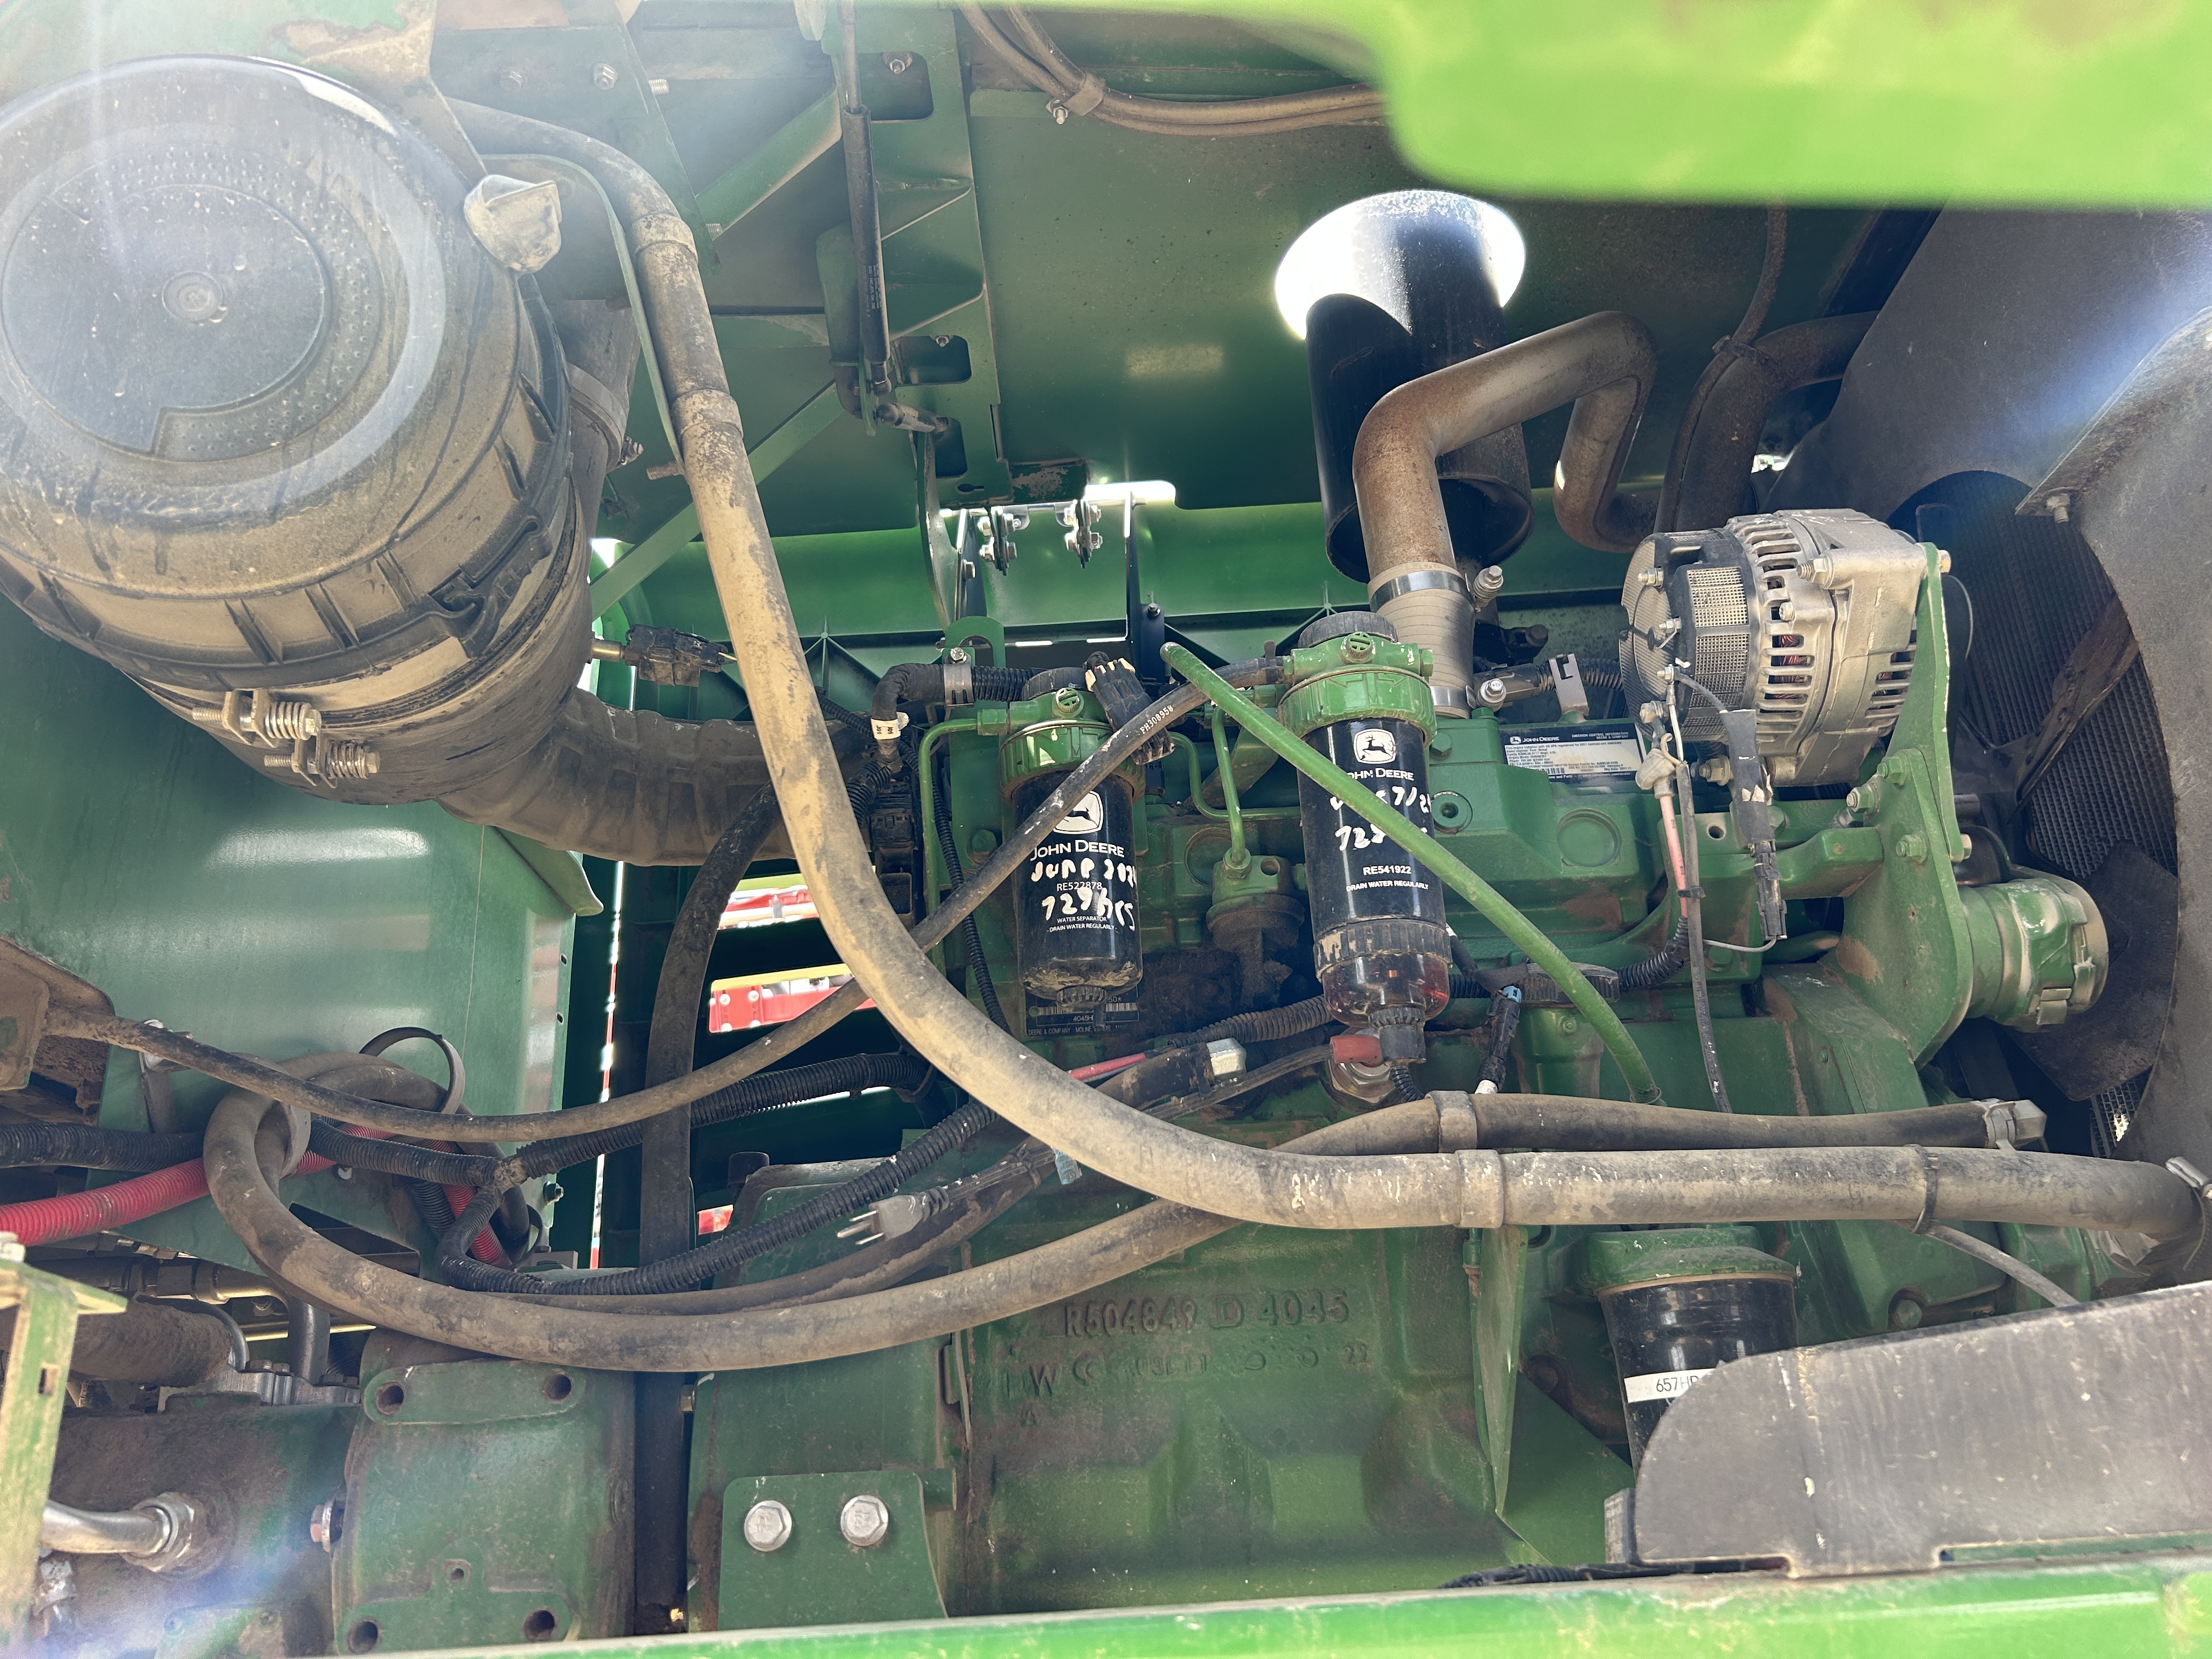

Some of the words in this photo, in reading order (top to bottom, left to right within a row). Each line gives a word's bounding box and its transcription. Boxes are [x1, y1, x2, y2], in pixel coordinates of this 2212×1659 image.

[1347, 770, 1374, 780] OHN
[1375, 768, 1414, 781] DEERE
[1030, 842, 1071, 861] JOHN
[1075, 839, 1125, 857] DEERE
[1363, 865, 1412, 875] RE541922
[1057, 881, 1103, 891] RE522878
[1346, 882, 1368, 891] DRAIN
[1393, 881, 1429, 890] REGULARLY
[1257, 1288, 1351, 1327] 4045
